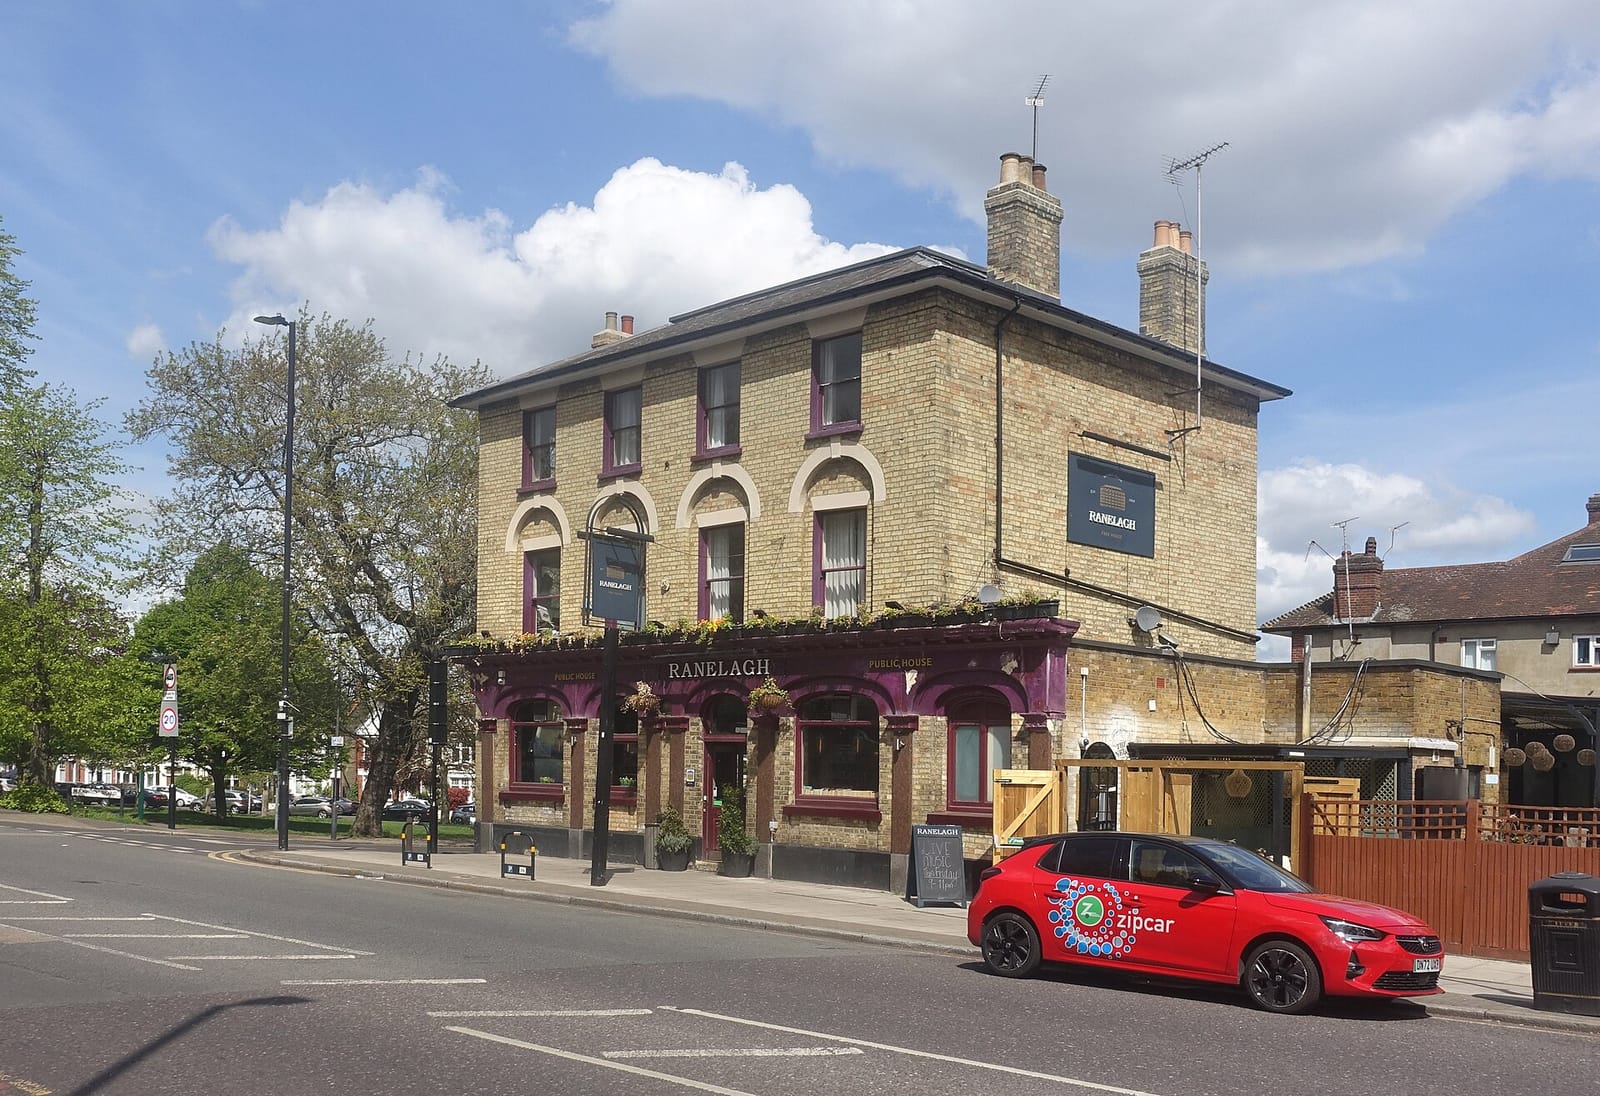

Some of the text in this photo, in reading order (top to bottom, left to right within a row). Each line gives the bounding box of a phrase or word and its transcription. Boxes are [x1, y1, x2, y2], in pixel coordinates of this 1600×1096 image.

[1088, 510, 1137, 531] RANELAGH
[599, 580, 632, 591] RANELAGH
[668, 659, 770, 679] RANELAGH
[869, 657, 933, 669] PUBLIC HOUSE
[576, 672, 597, 680] HOUSE
[163, 715, 175, 725] 20
[917, 828, 958, 836] RANELAGH
[921, 841, 952, 856] LIVE
[922, 855, 952, 869] MUSIC
[1117, 910, 1175, 934] zipcar
